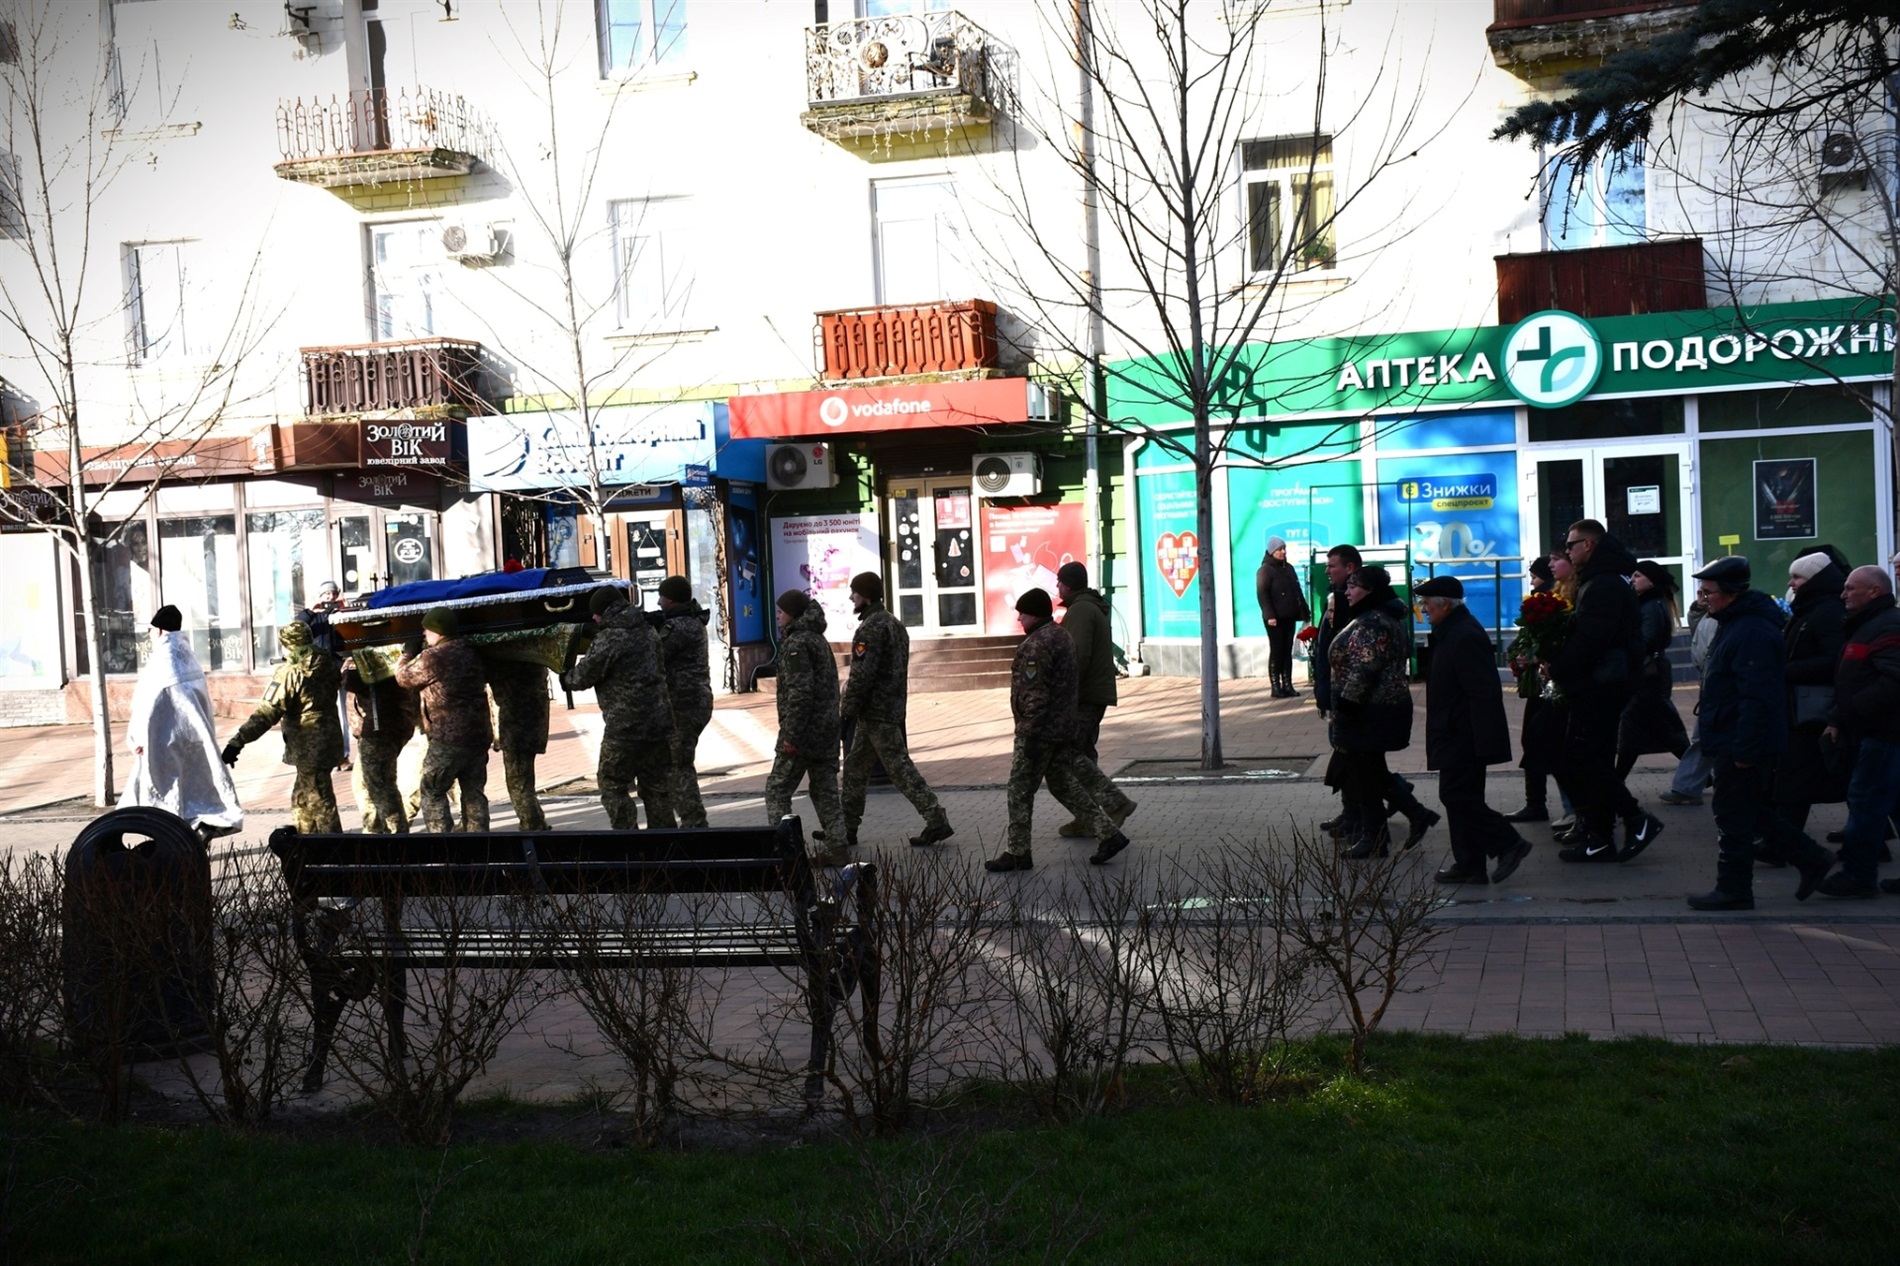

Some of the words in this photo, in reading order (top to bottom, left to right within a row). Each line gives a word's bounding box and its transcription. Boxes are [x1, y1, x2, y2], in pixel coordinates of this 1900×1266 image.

[1336, 352, 1496, 391] АПТЕКА
[852, 398, 931, 417] vodafone
[366, 456, 418, 466] ювелірний
[419, 457, 446, 465] завод
[783, 521, 812, 530] Даруємо
